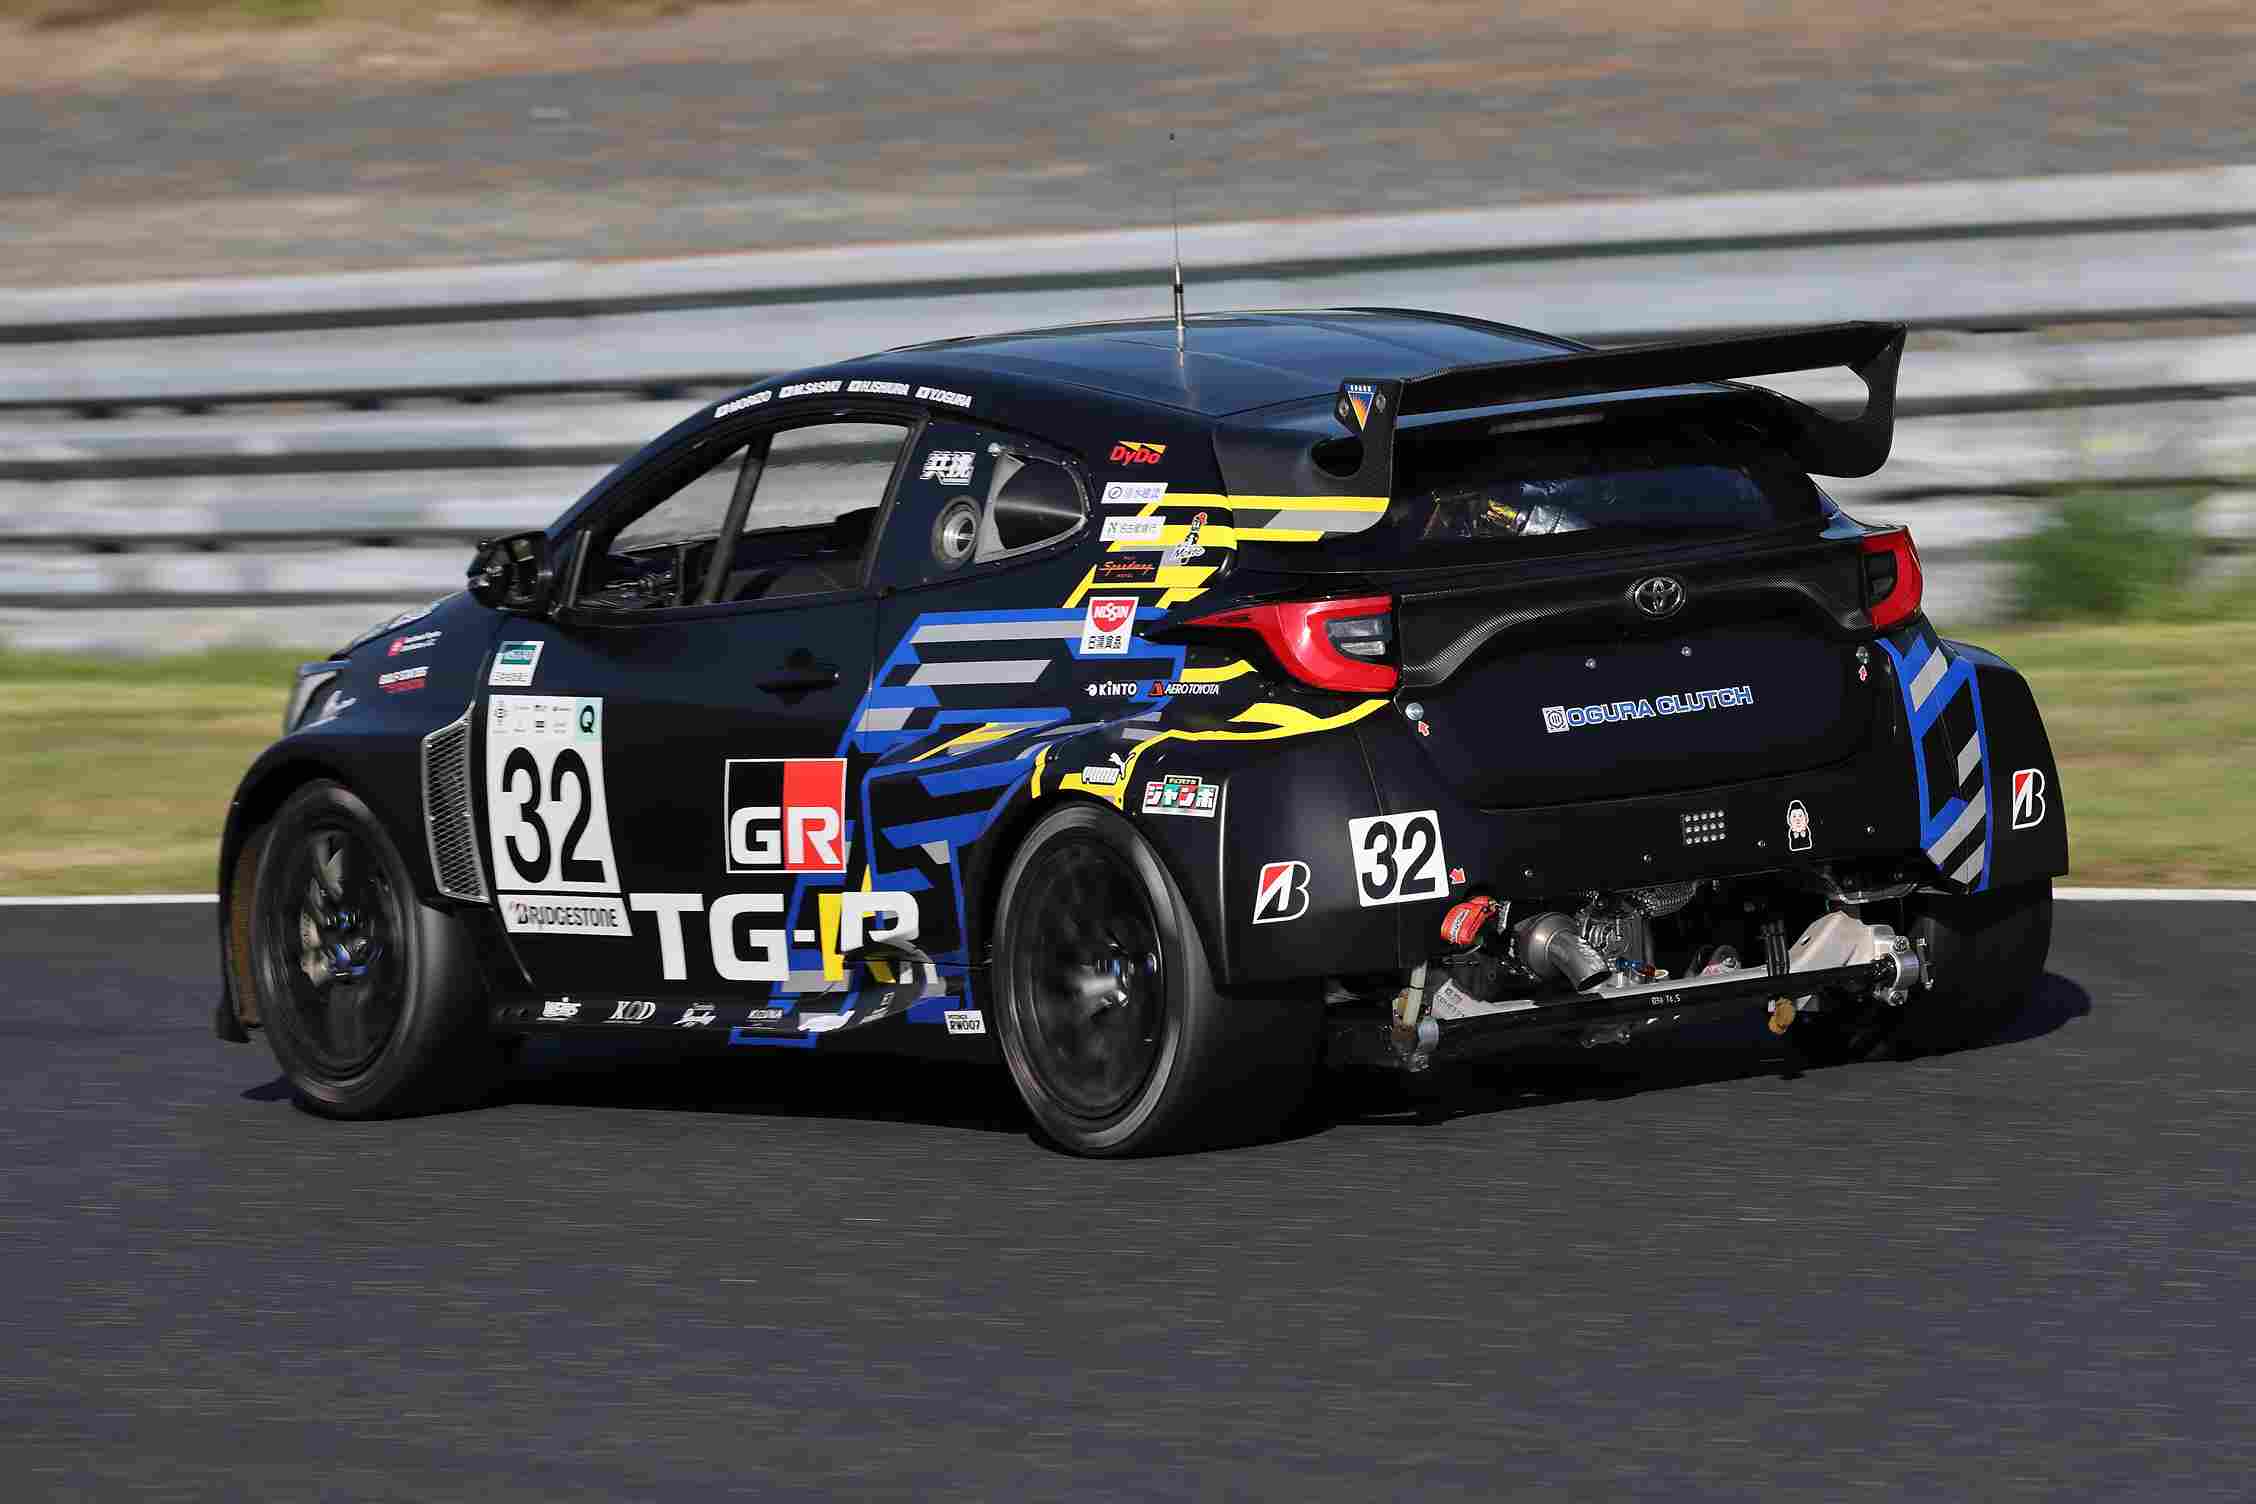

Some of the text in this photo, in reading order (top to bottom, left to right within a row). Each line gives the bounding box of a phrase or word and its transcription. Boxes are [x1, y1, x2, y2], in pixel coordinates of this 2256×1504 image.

[1109, 446, 1161, 466] DyDo
[1094, 602, 1129, 622] NISSIN
[579, 704, 595, 734] Q
[1566, 685, 1754, 727] OGURA CLUTCH
[502, 746, 607, 884] 32
[730, 806, 841, 865] GR
[1360, 815, 1438, 900] 32
[511, 901, 618, 928] BRIDGESTONE
